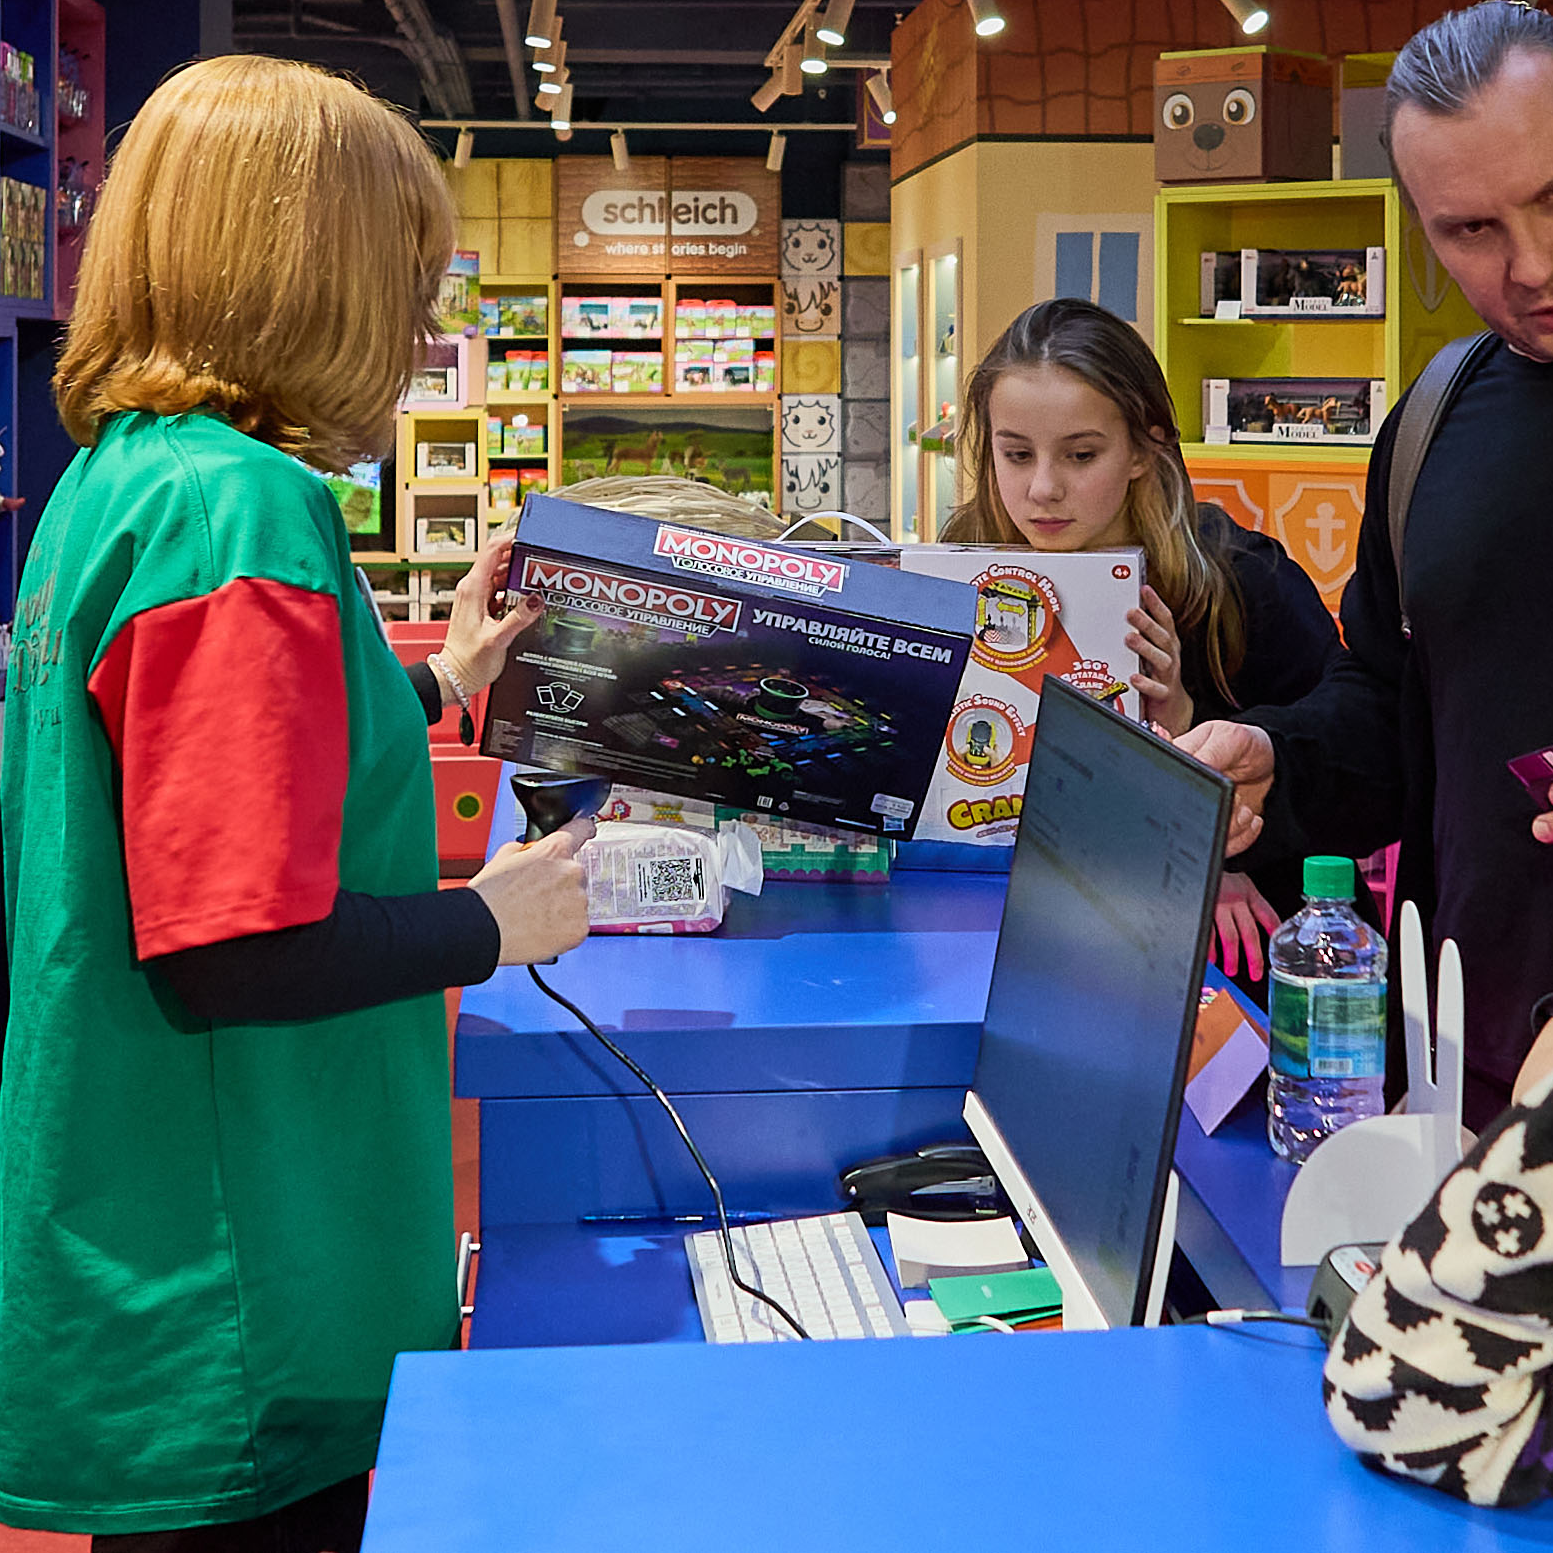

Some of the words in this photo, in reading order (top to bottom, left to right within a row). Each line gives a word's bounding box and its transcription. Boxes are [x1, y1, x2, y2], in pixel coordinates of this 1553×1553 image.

[602, 196, 739, 225] schleich
[605, 241, 649, 256] where
[708, 241, 747, 258] begin
[661, 533, 839, 585] MONOPOLY
[676, 556, 745, 578] ГОЛОСОВОЕ
[745, 571, 820, 595] УПРАВЛЕНИЕ
[1113, 567, 1129, 577] 4+
[530, 564, 735, 624] MONOPOLY
[546, 591, 625, 617] ГОЛОСОВОЕ
[625, 608, 710, 636] УПРАВЛЕНИЕ
[752, 608, 892, 652] УПРАВЛЯЙТЕ
[892, 638, 953, 664] ВСЕМ
[808, 635, 845, 651] СИЛОЙ
[845, 642, 892, 660] ГОЛОСА!
